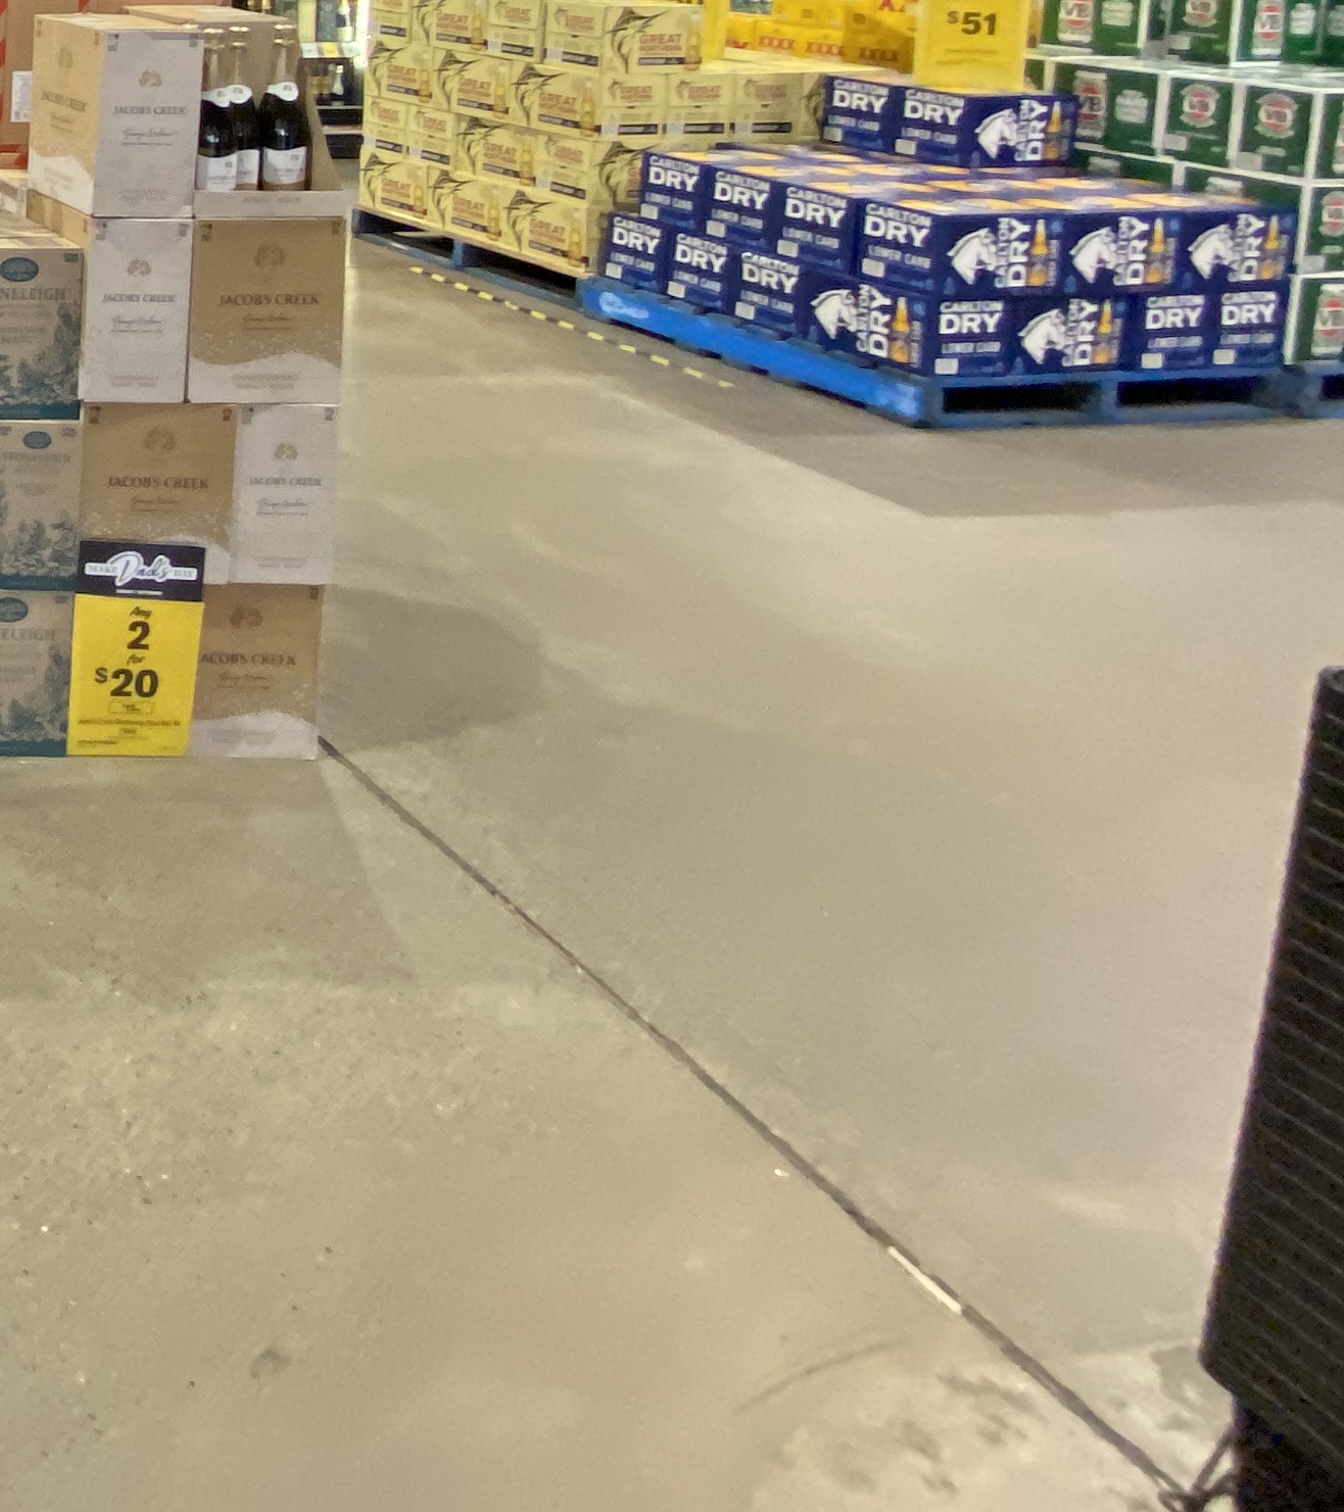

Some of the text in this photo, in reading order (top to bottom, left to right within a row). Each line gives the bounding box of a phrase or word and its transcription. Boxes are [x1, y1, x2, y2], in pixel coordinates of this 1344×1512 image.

[947, 10, 998, 36] $51
[639, 33, 682, 44] GREAT
[153, 105, 186, 115] CREEK
[832, 90, 889, 114] DRY
[903, 100, 964, 126] DRY
[648, 166, 700, 193] DRY
[715, 170, 770, 193] CARLTON
[714, 182, 770, 210] DRY
[786, 187, 847, 209] CARLTON
[785, 198, 847, 229] DRY
[865, 203, 933, 228] CARLTON
[612, 227, 661, 255] DRY
[864, 215, 931, 248] DRY
[675, 244, 727, 274] DRY
[741, 251, 800, 277] CARLTON
[741, 263, 799, 294] DRY
[142, 293, 176, 303] CREEK
[275, 293, 320, 306] CREEK
[939, 313, 1003, 335] DRY
[1145, 307, 1204, 330] DRY
[1221, 303, 1278, 326] DRY
[163, 477, 209, 489] CREEK
[289, 476, 322, 487] CREEK
[129, 606, 153, 619] Any
[127, 621, 151, 650] 2
[251, 653, 297, 666] CREEK
[94, 667, 159, 699] $20
